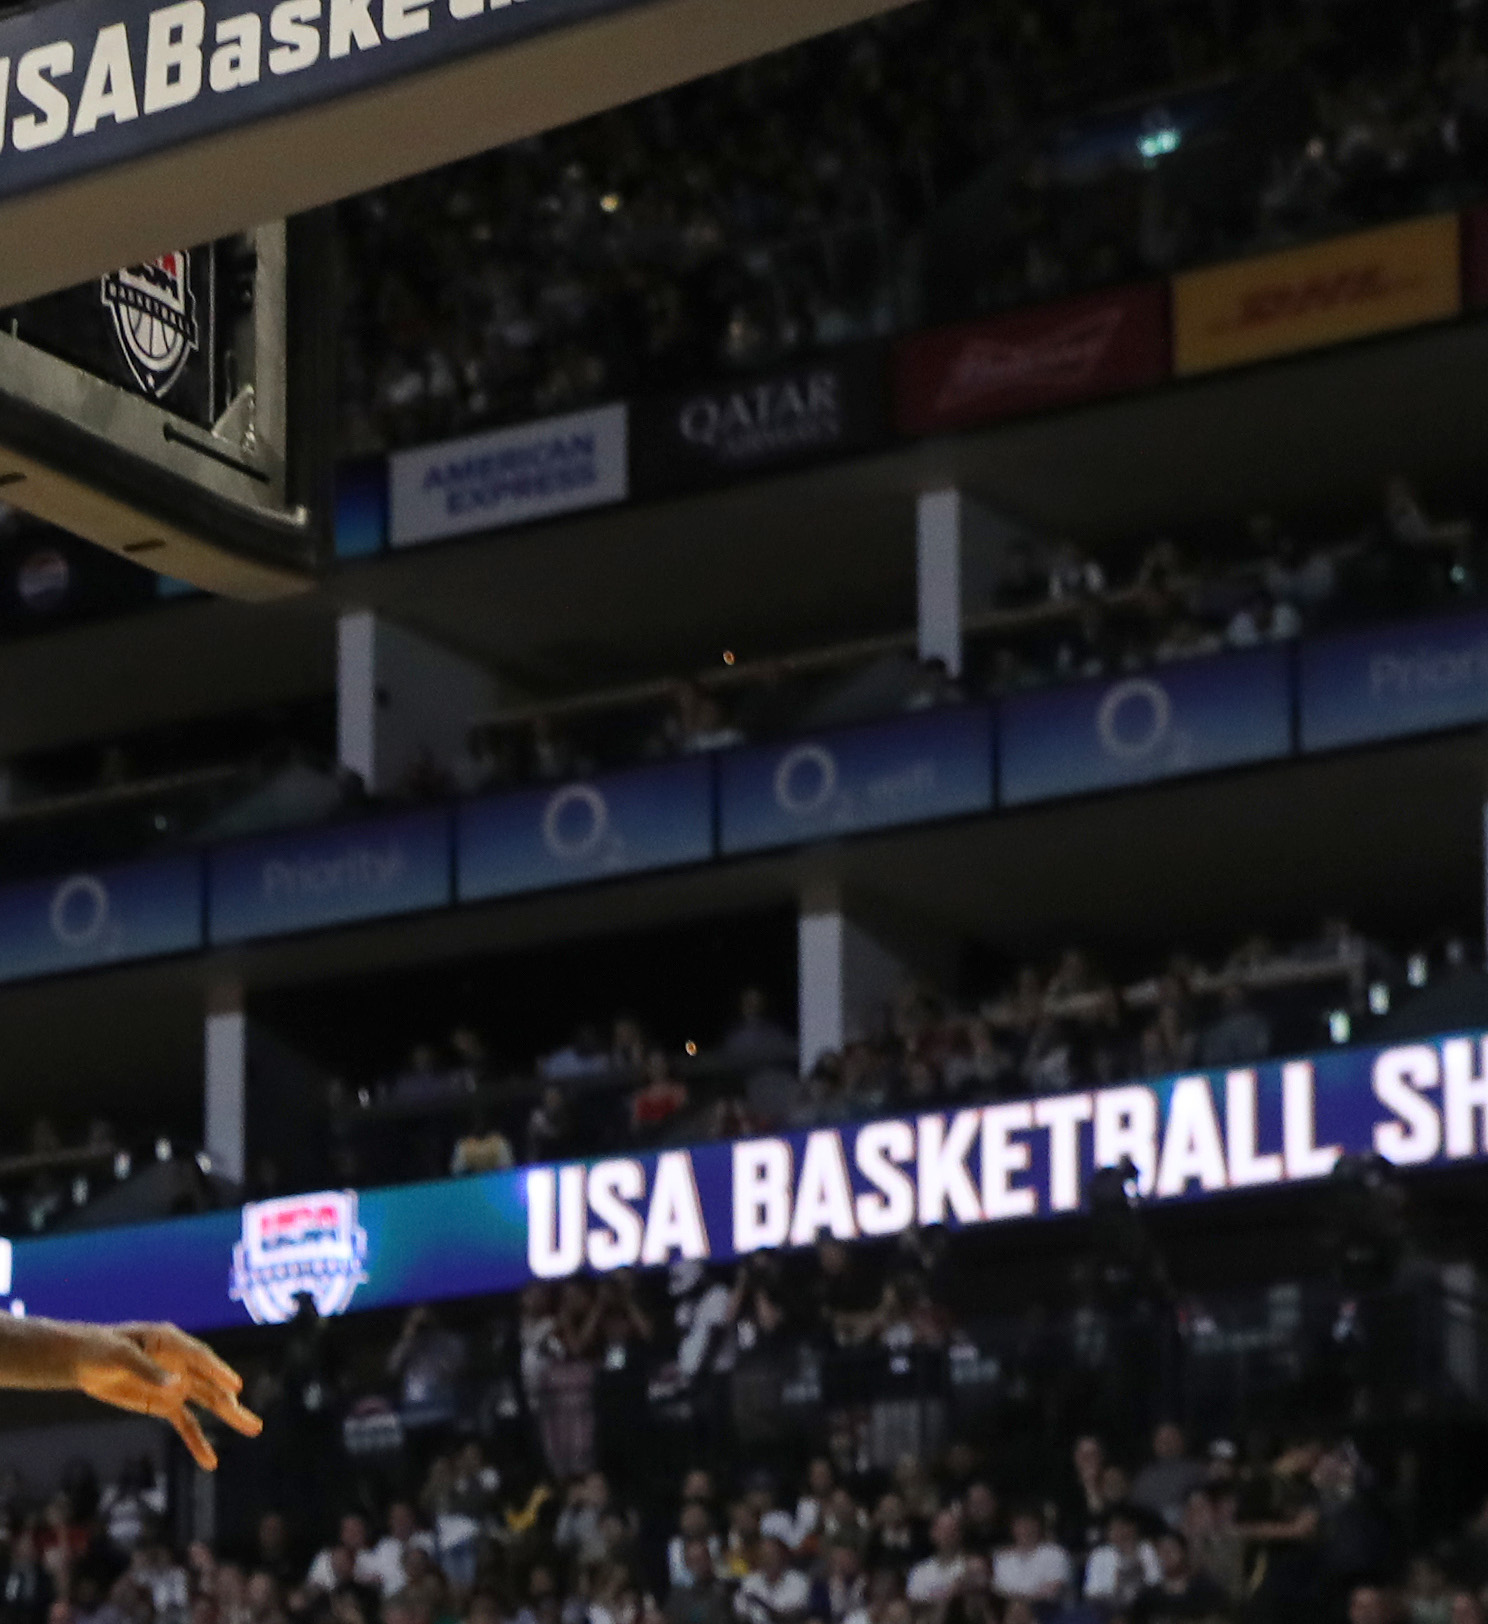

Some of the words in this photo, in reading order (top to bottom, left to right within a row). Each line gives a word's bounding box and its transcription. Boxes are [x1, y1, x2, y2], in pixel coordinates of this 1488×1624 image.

[679, 370, 839, 447] QATAR
[423, 432, 596, 493] AMERICAN
[445, 462, 598, 517] EXPRESS
[522, 1150, 711, 1280] USA
[732, 1063, 1342, 1254] BASKETBALL
